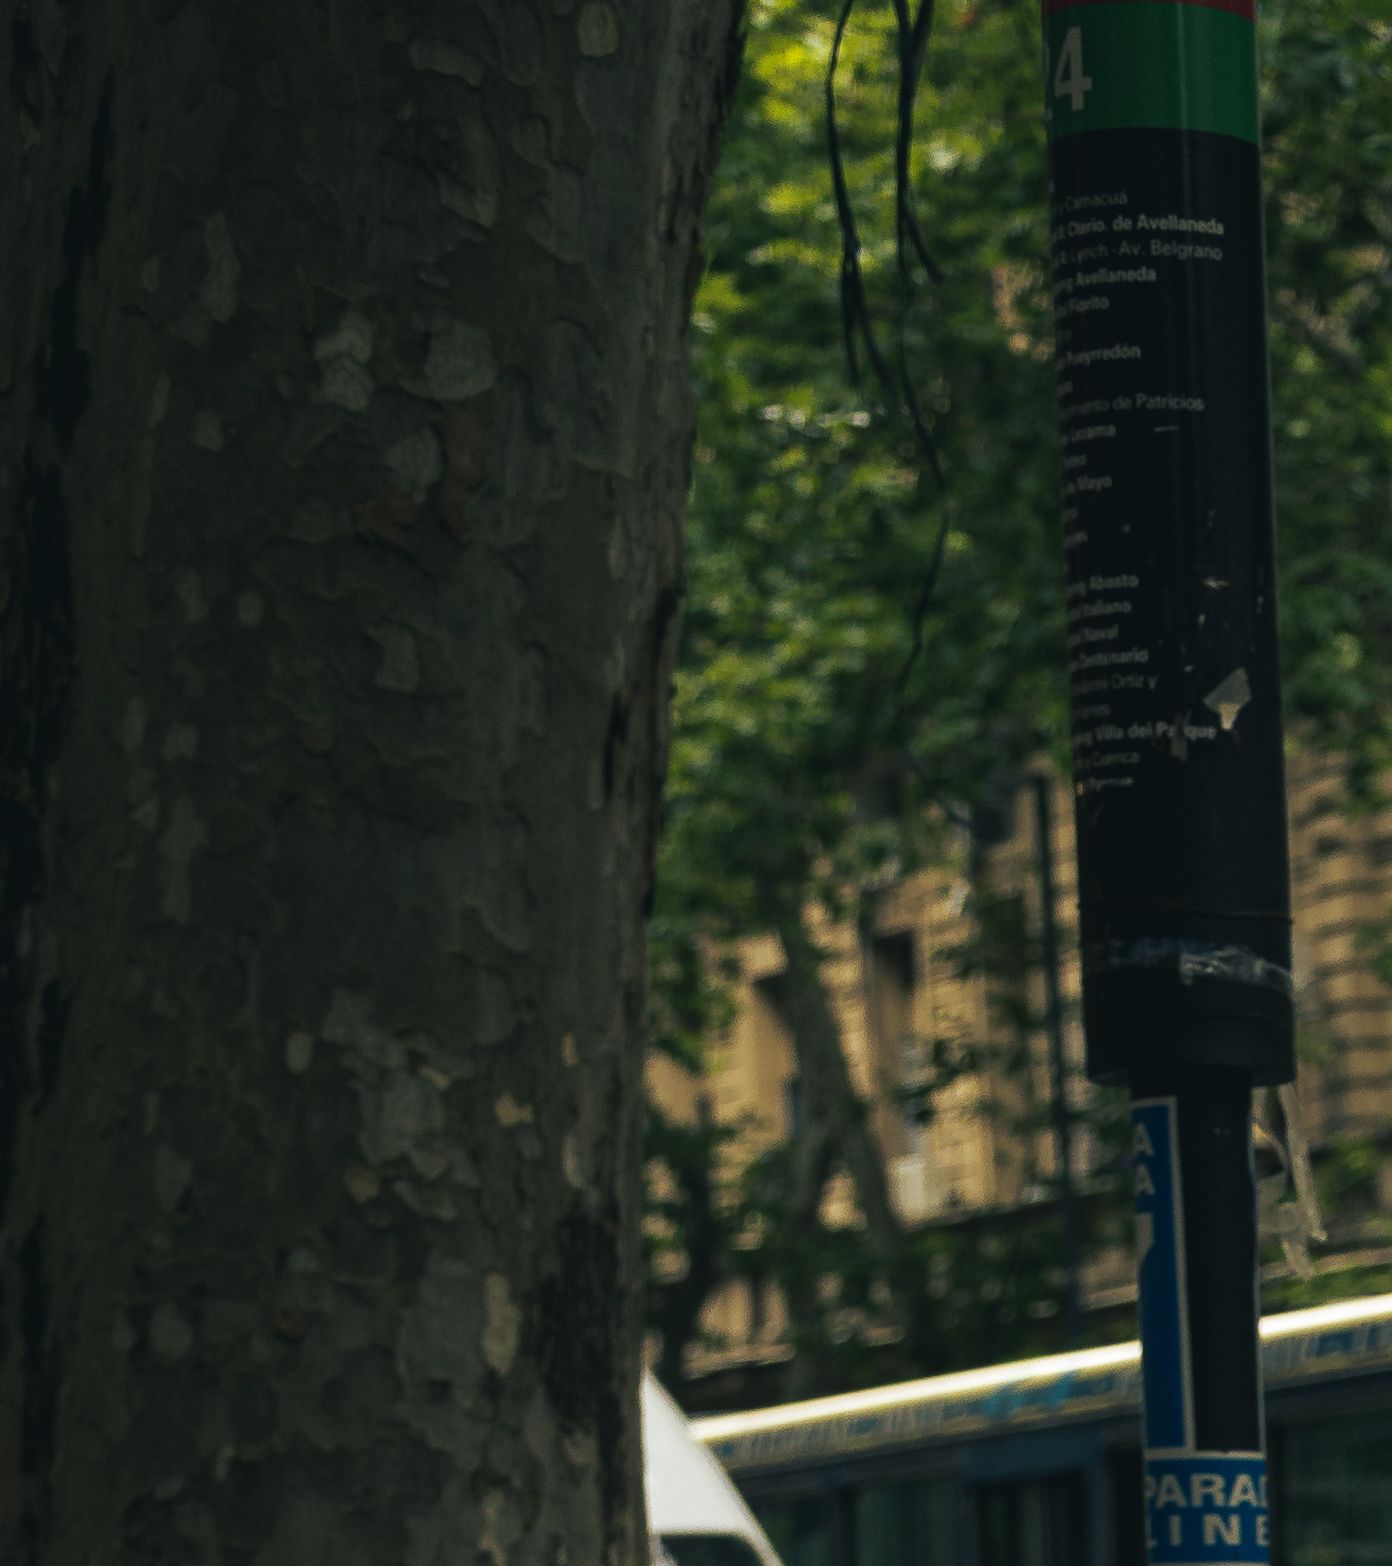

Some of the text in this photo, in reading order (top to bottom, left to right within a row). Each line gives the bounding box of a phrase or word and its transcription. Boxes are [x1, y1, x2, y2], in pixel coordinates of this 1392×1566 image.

[1112, 214, 1133, 233] de
[1137, 213, 1225, 237] Avellaneda
[1119, 241, 1146, 257] Av.
[1150, 238, 1224, 262] Belgrano
[1112, 394, 1133, 411] de
[1135, 391, 1206, 412] Patricios
[1127, 721, 1153, 740] del
